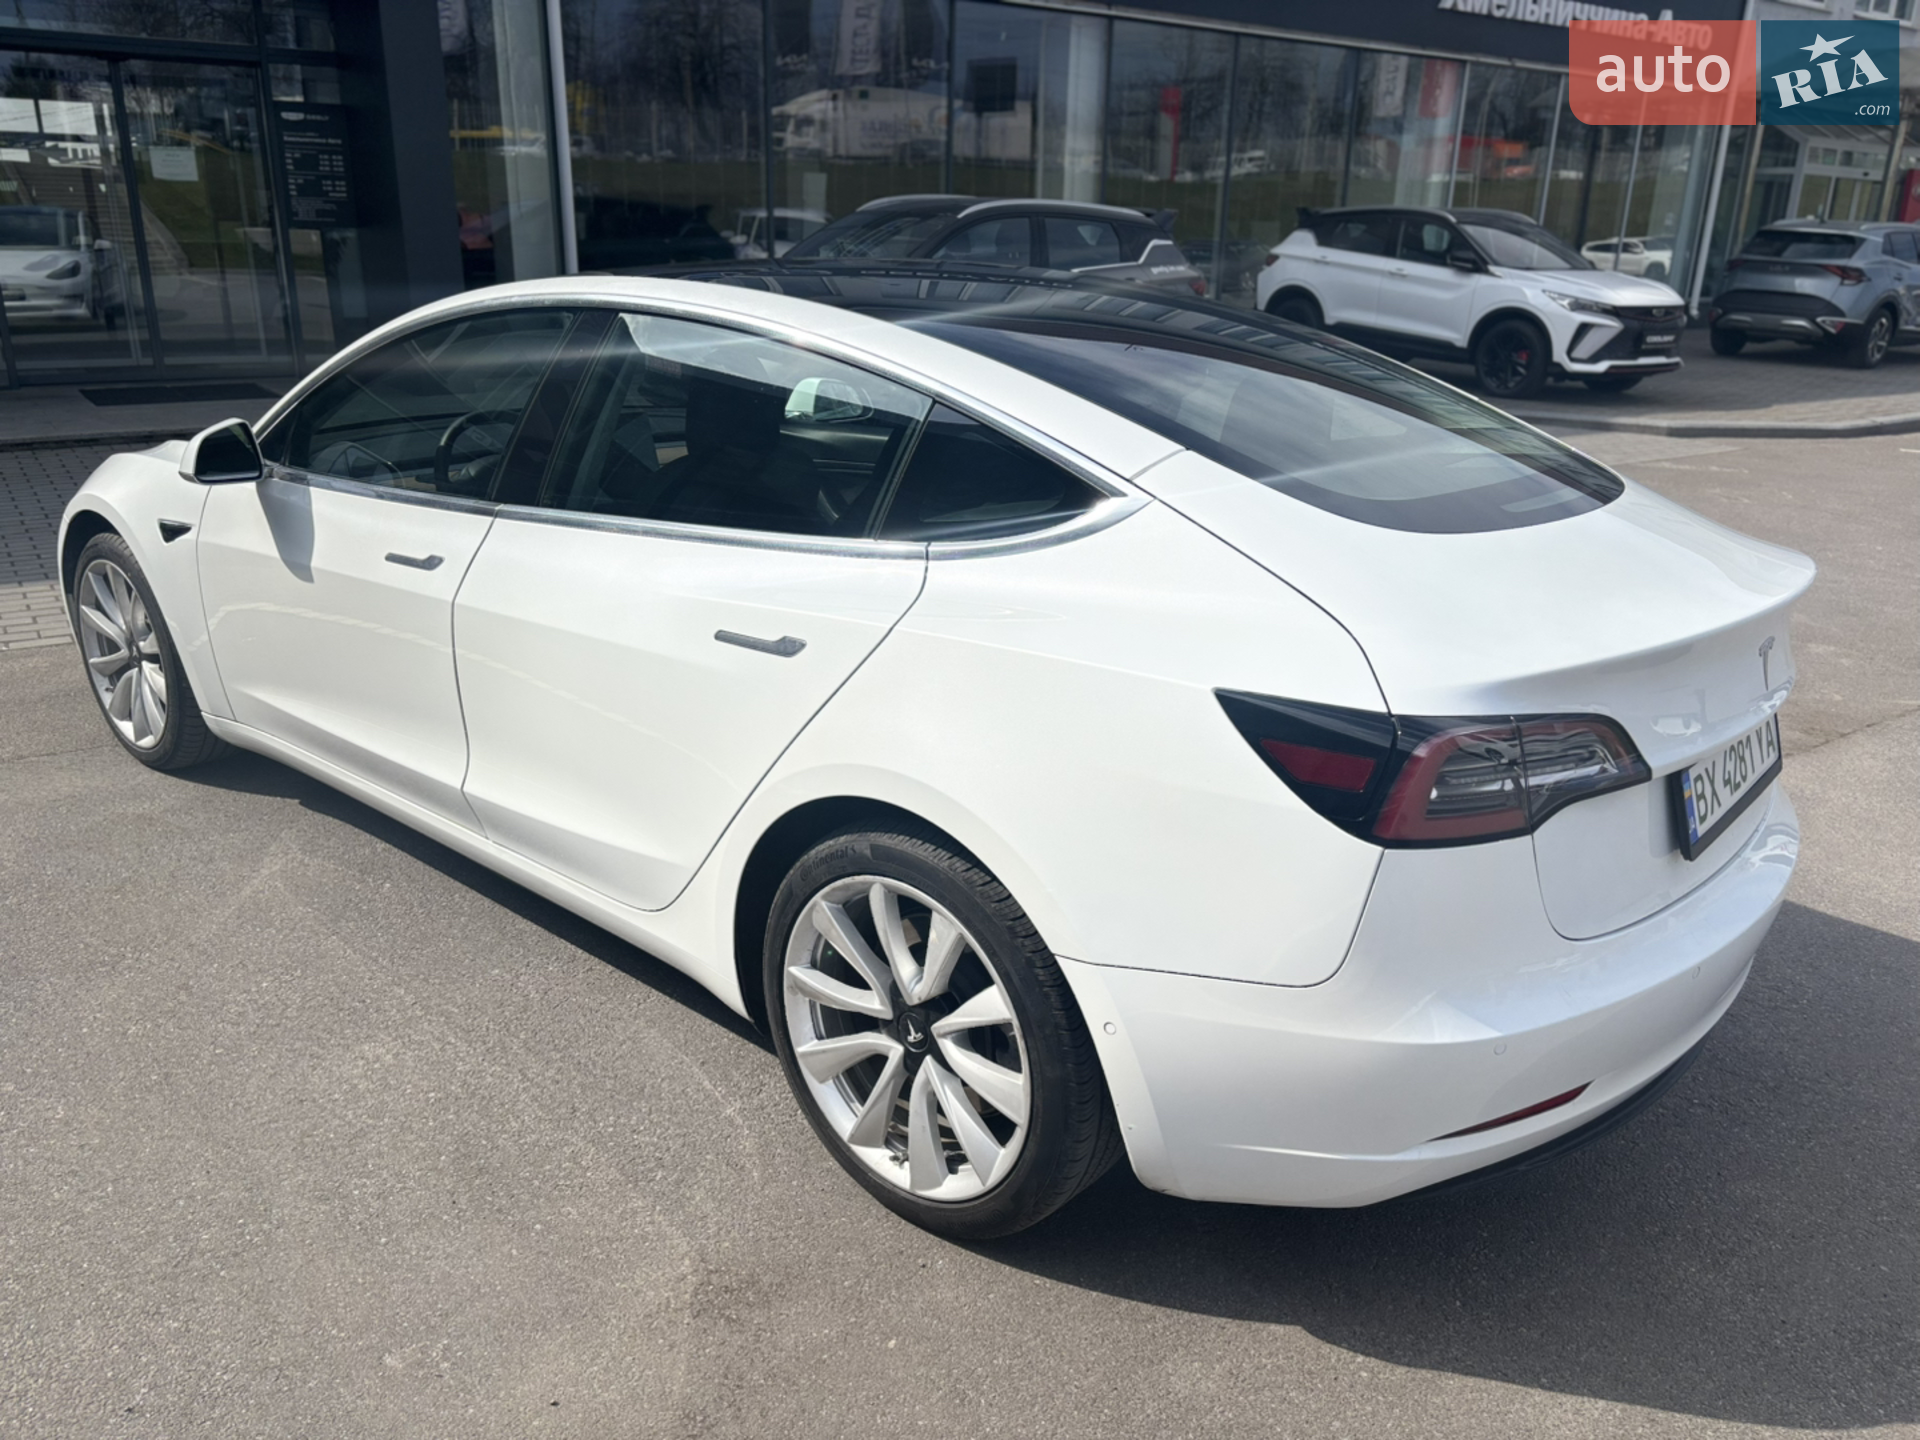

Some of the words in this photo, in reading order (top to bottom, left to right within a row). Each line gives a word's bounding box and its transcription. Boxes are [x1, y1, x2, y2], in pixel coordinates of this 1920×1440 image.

[1437, 0, 1713, 51] мельниччина-Авто
[1693, 760, 1722, 826] BX
[1722, 734, 1755, 796] 4281
[1756, 720, 1776, 765] YA
[800, 846, 848, 882] Continental
